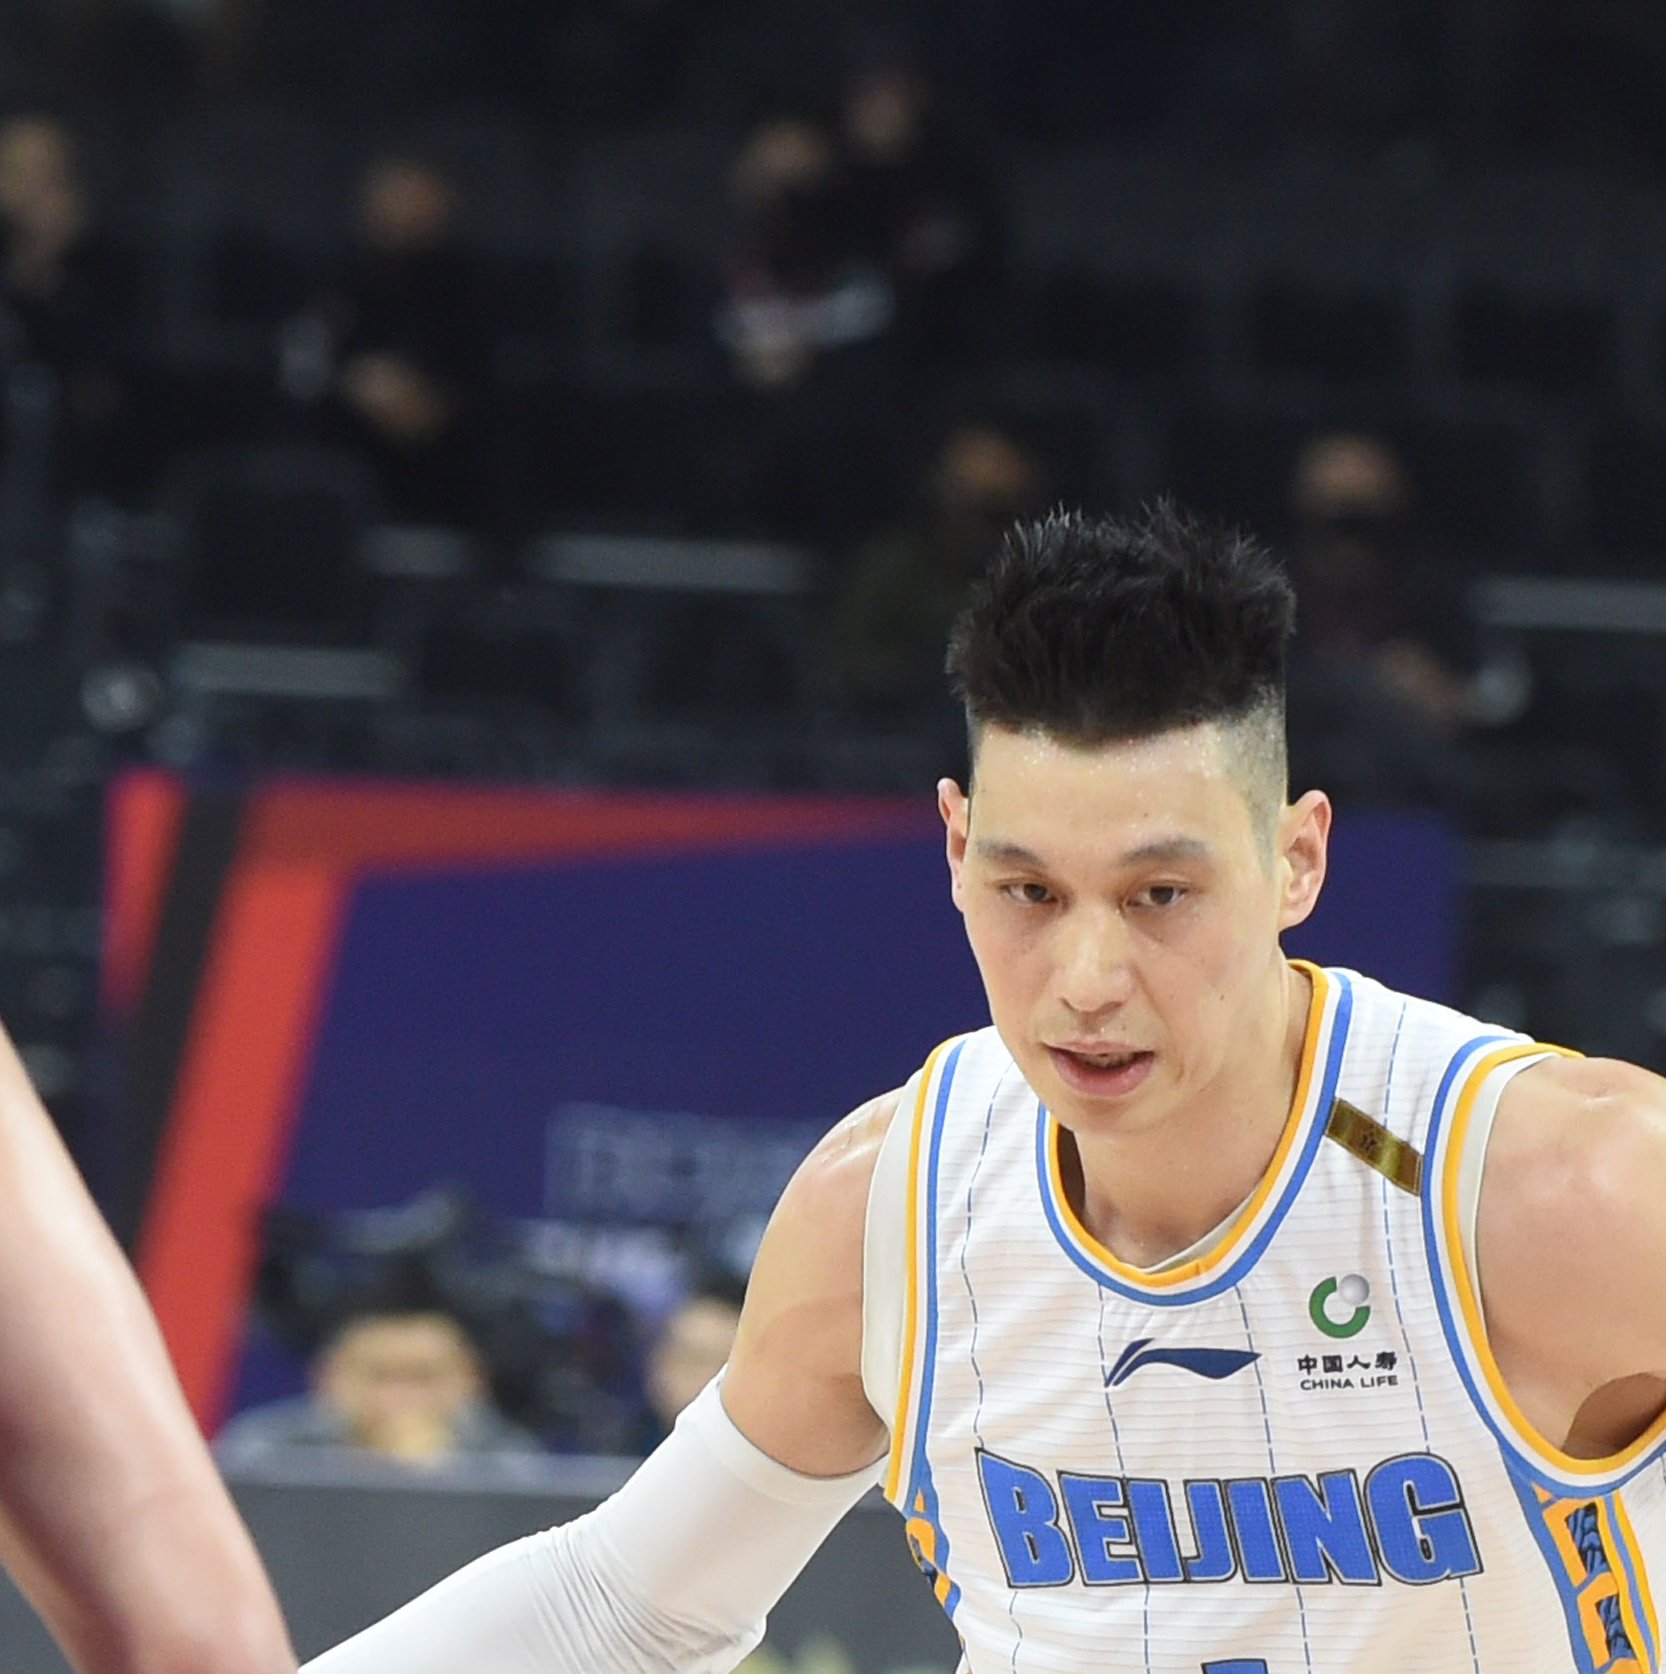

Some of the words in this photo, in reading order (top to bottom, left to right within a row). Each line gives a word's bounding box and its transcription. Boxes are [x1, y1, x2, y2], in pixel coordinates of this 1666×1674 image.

[1300, 1378, 1354, 1391] CHINA
[1361, 1375, 1398, 1388] LIFE
[974, 1446, 1482, 1588] BEIJING
